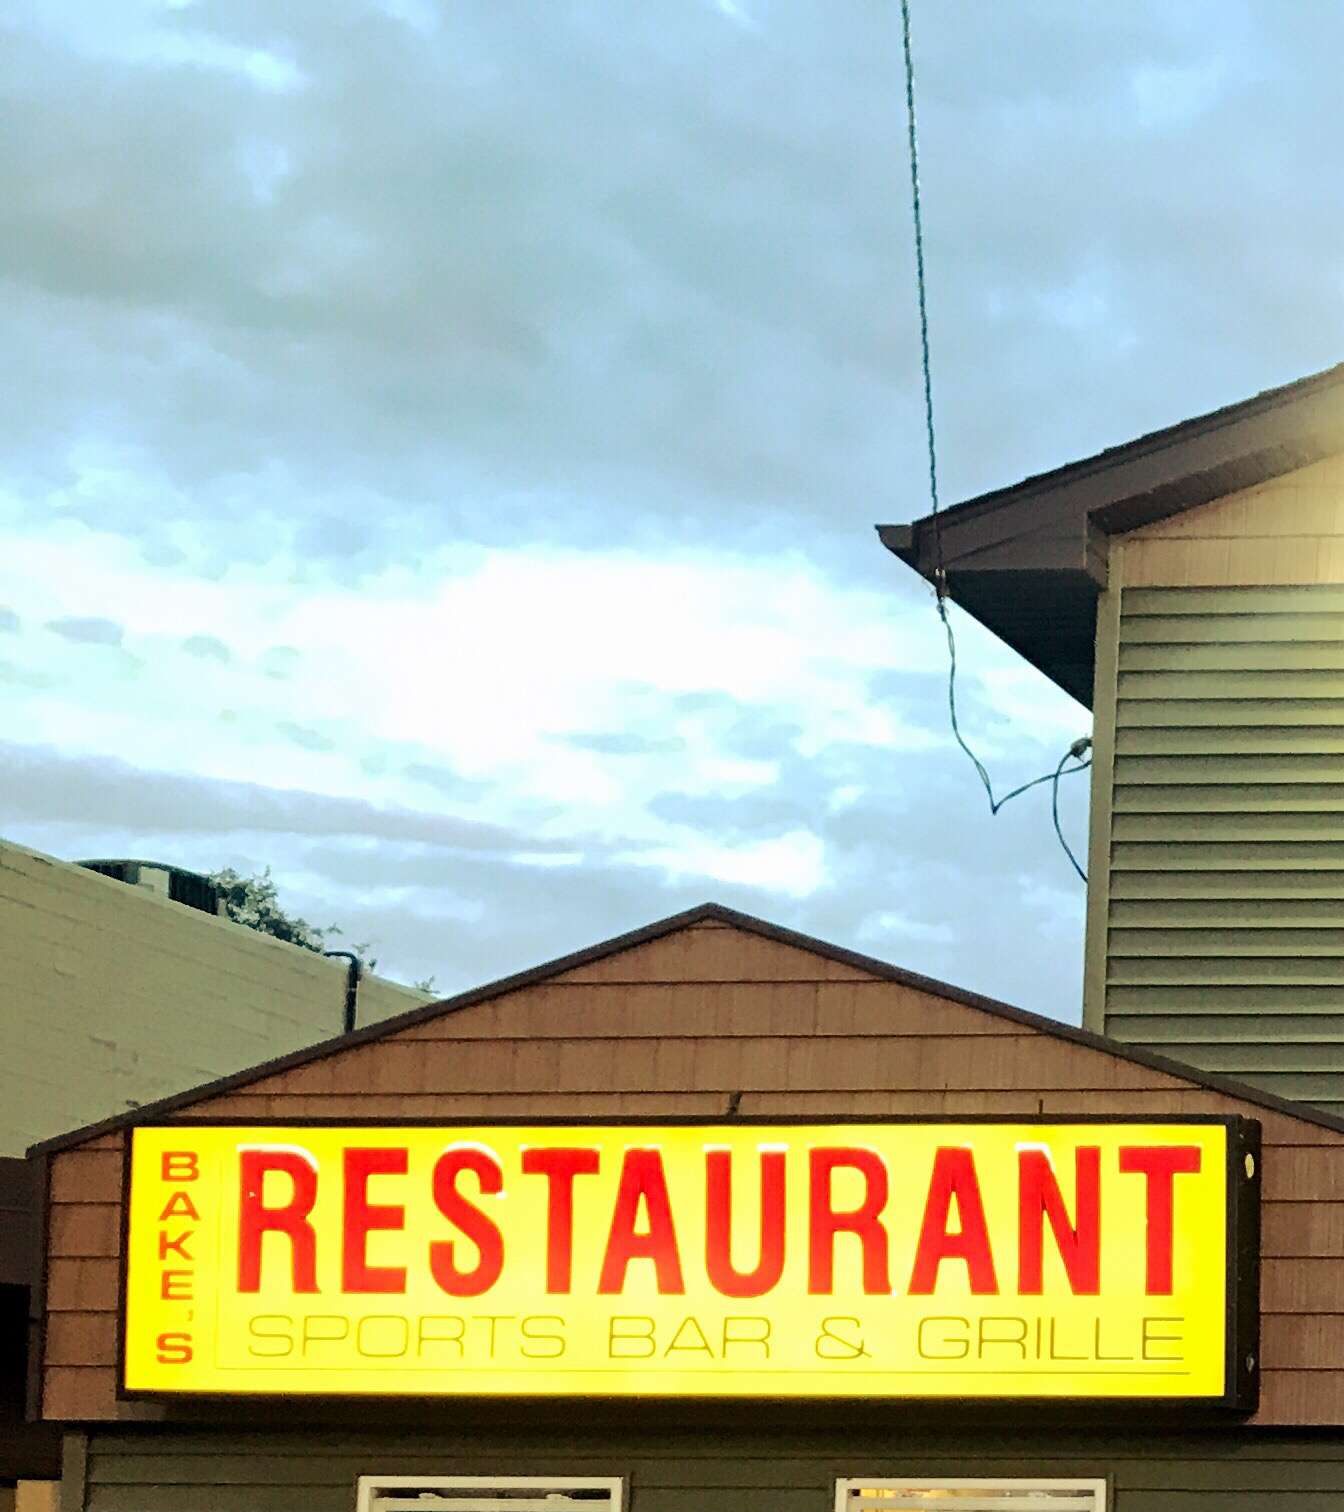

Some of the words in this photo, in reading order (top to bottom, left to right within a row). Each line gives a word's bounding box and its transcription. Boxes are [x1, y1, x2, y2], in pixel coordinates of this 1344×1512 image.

[237, 1144, 1202, 1298] RESTAURANT
[248, 1314, 567, 1359] SPORTS
[608, 1315, 772, 1359] BAR
[815, 1316, 873, 1360] &
[917, 1316, 1185, 1361] GRILLE
